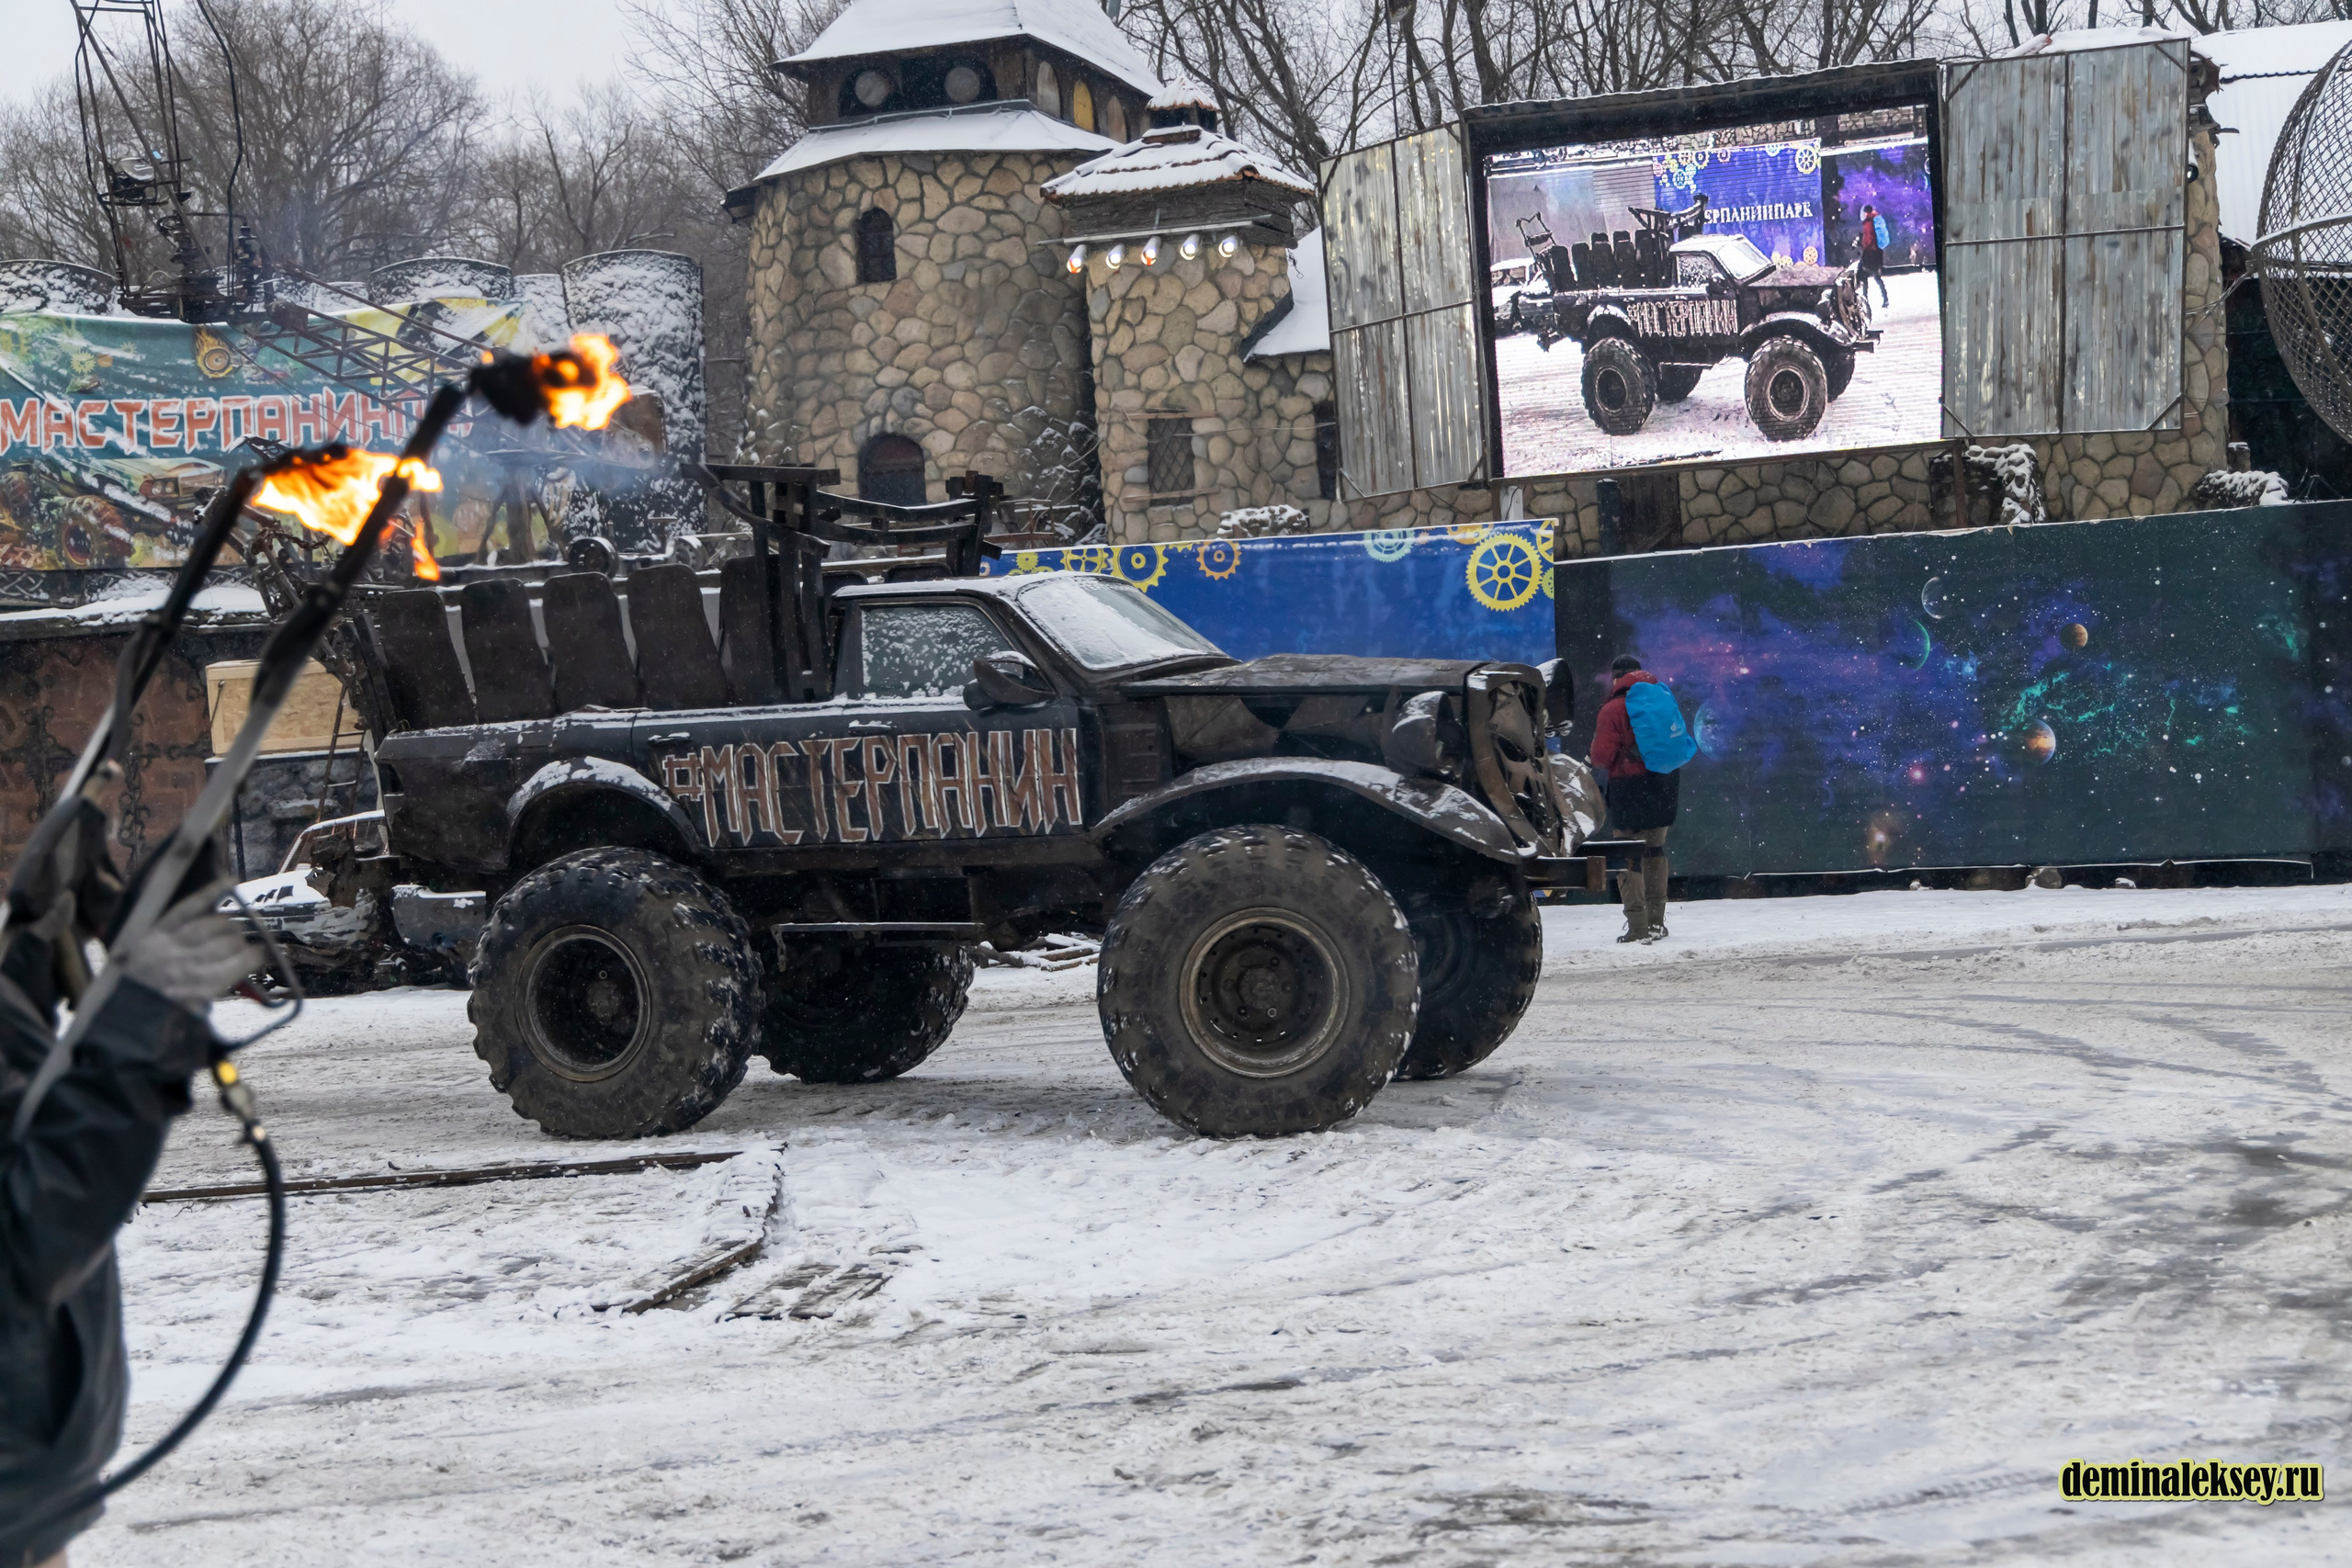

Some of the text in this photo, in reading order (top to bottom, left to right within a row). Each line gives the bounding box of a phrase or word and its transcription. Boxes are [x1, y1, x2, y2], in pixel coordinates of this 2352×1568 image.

[1668, 201, 1814, 226] ЕРПАНИНПАРК
[0, 385, 474, 457] МАСТЕРПАНИНП
[662, 727, 1083, 848] #МАСТЕРПАНИН
